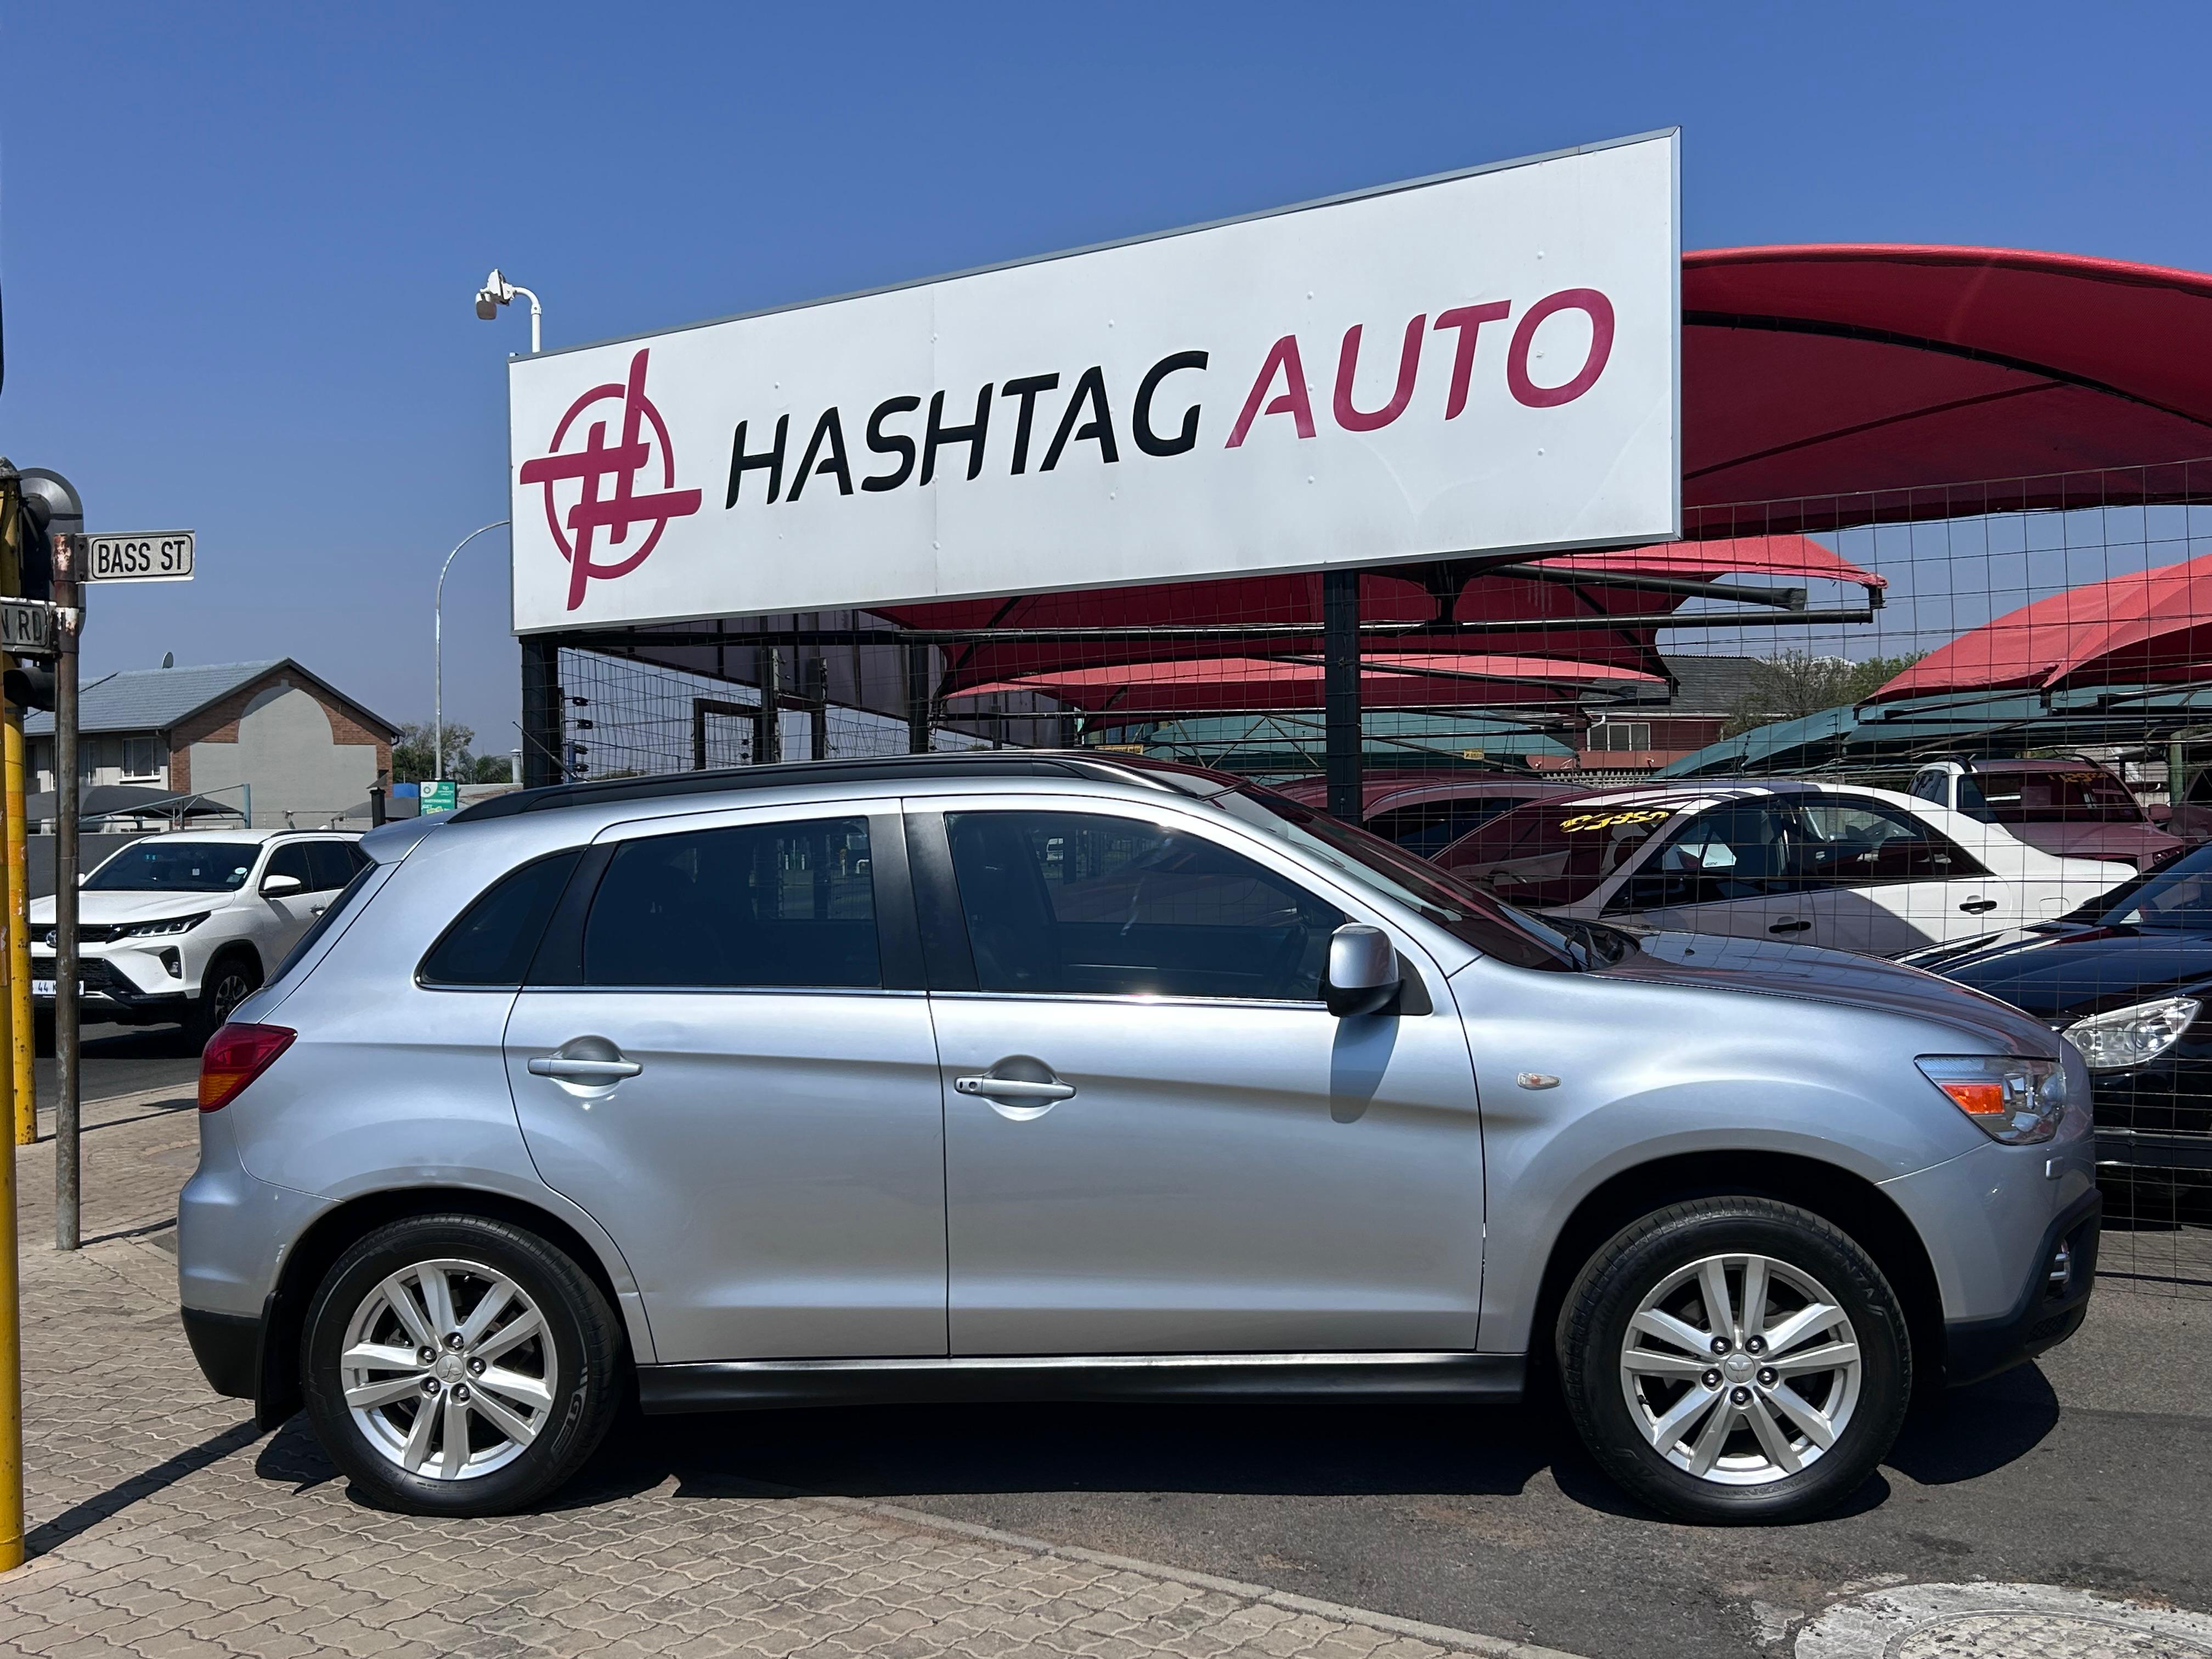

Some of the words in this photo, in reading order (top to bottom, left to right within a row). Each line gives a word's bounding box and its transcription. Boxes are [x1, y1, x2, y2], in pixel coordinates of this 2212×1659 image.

[725, 351, 1209, 510] HASHTAG
[1227, 289, 1614, 448] AUTO
[98, 542, 150, 573] BASS
[161, 540, 185, 571] ST
[18, 610, 42, 641] RD
